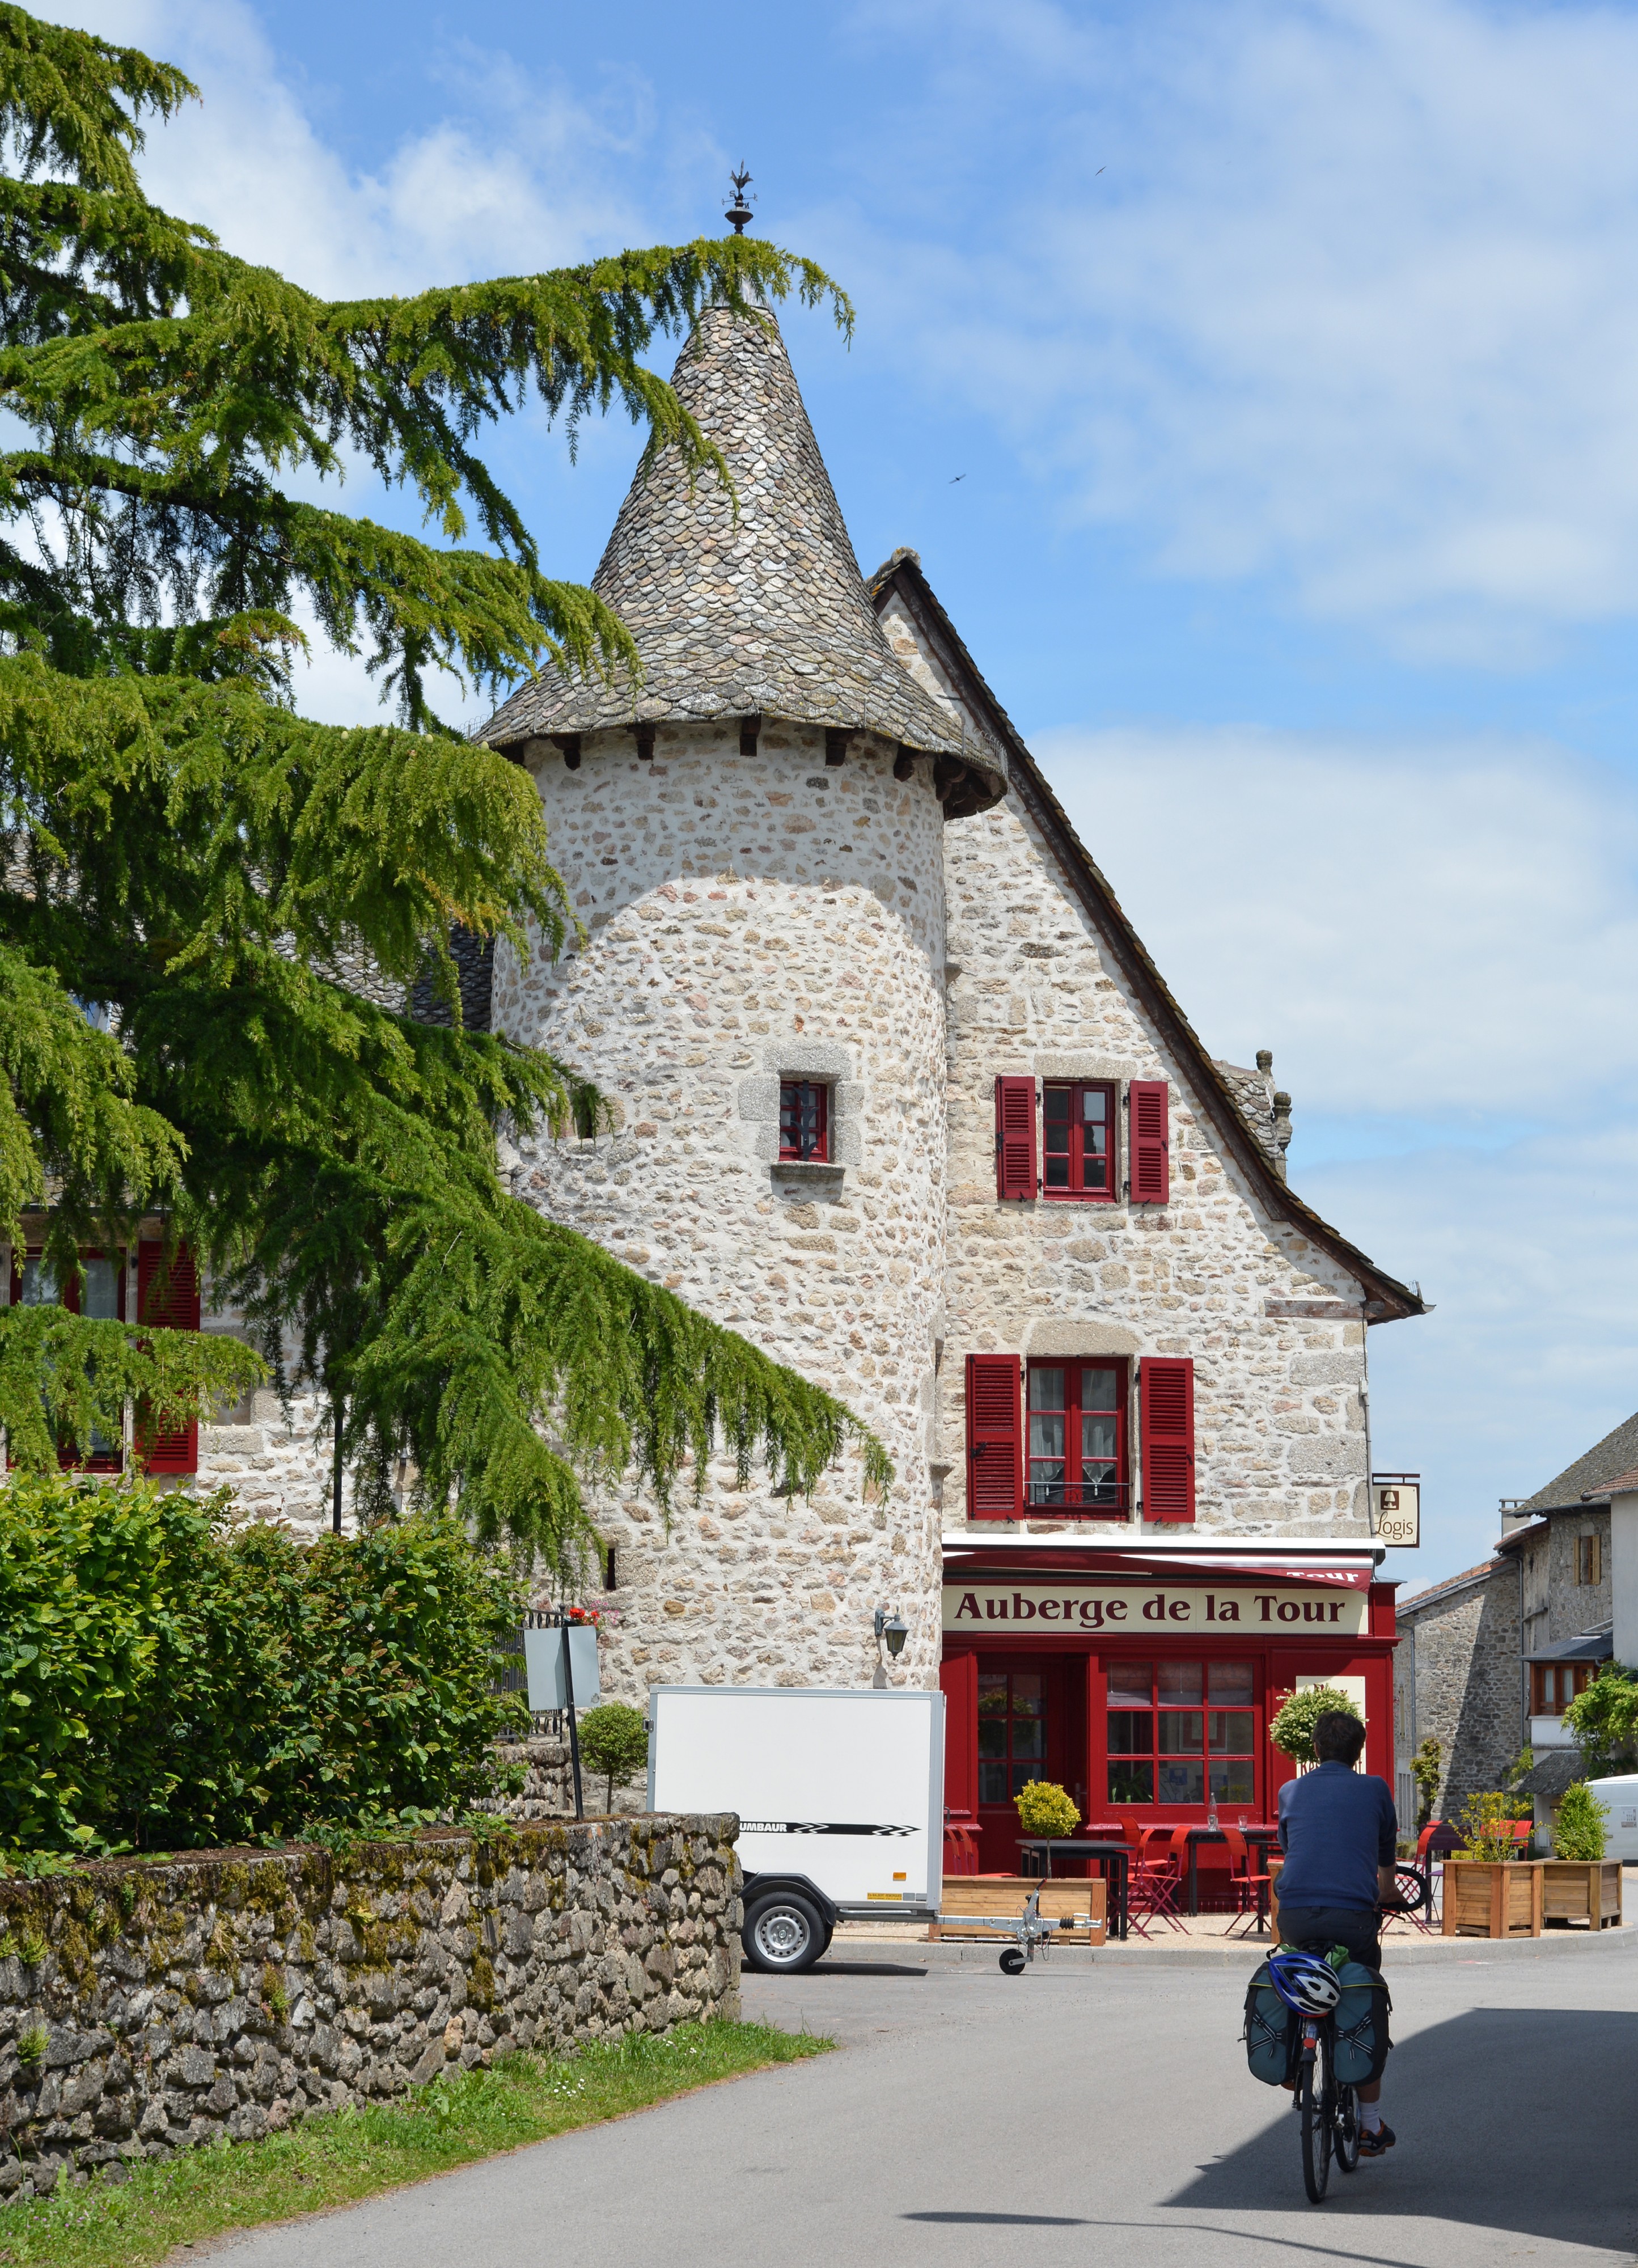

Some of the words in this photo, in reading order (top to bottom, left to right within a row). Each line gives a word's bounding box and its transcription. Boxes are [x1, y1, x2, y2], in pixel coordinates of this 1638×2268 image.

[1374, 1511, 1413, 1540] Logis
[954, 1593, 1128, 1628] Auberge
[1142, 1594, 1191, 1621] de
[1205, 1594, 1241, 1622] la
[1254, 1595, 1345, 1622] Tour
